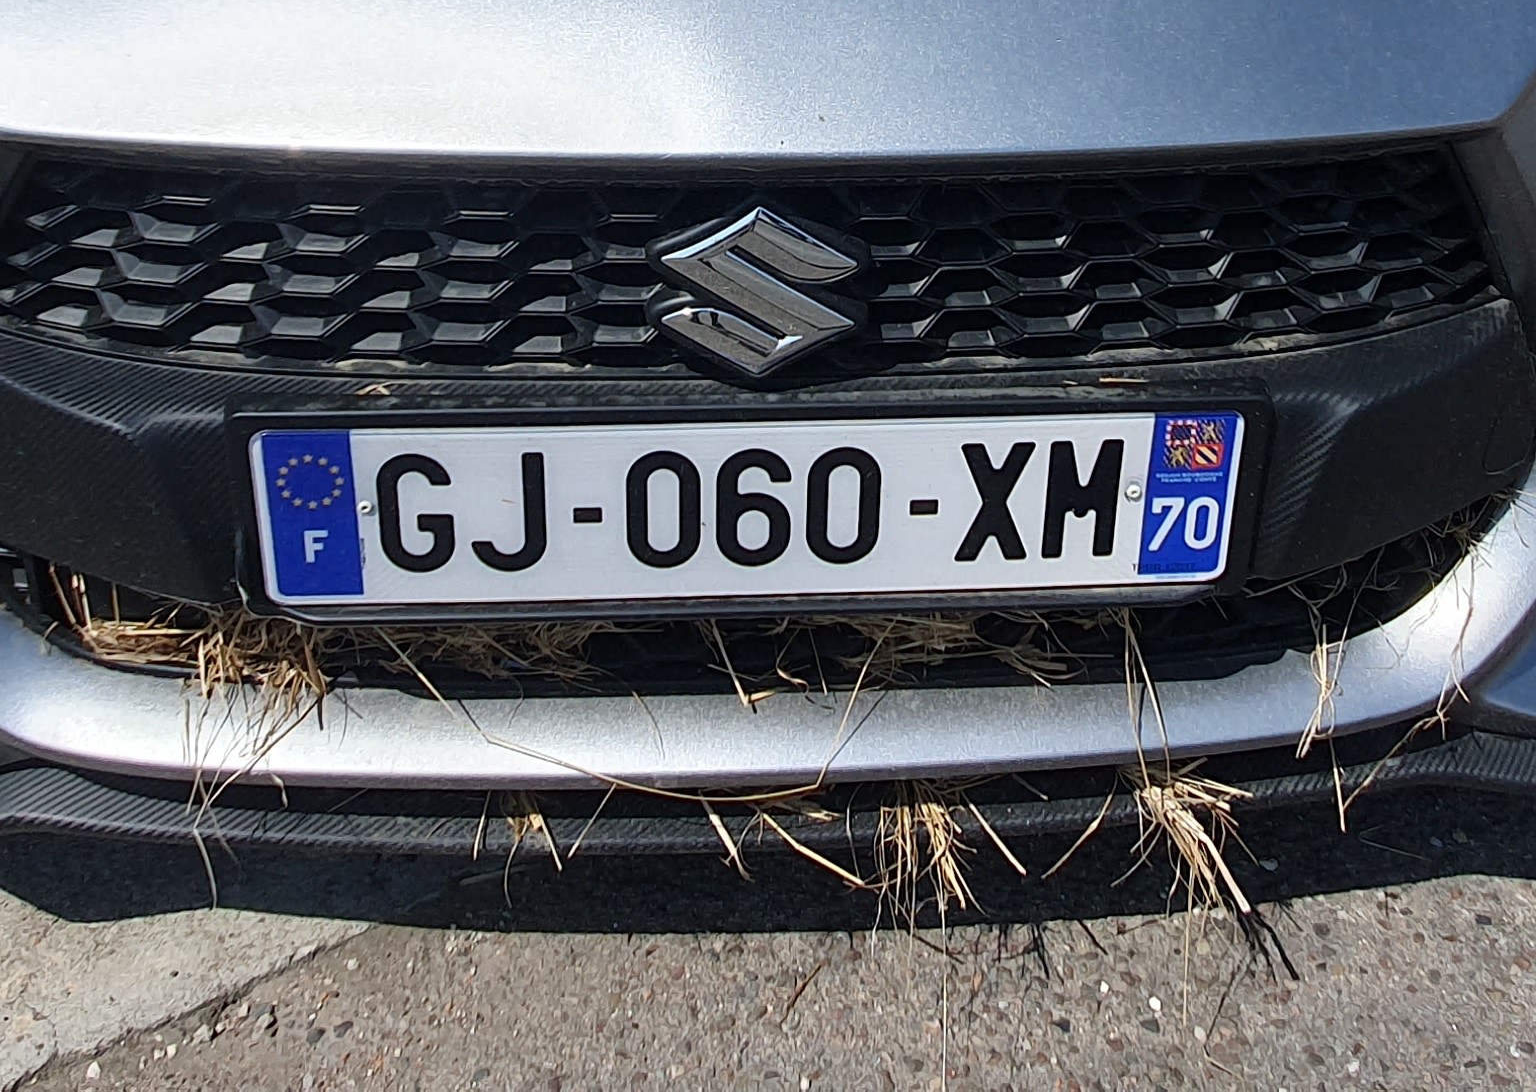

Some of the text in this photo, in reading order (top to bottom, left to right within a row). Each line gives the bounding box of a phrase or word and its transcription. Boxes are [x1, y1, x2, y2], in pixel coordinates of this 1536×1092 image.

[303, 437, 1220, 574] F GJ-060-XM 70
